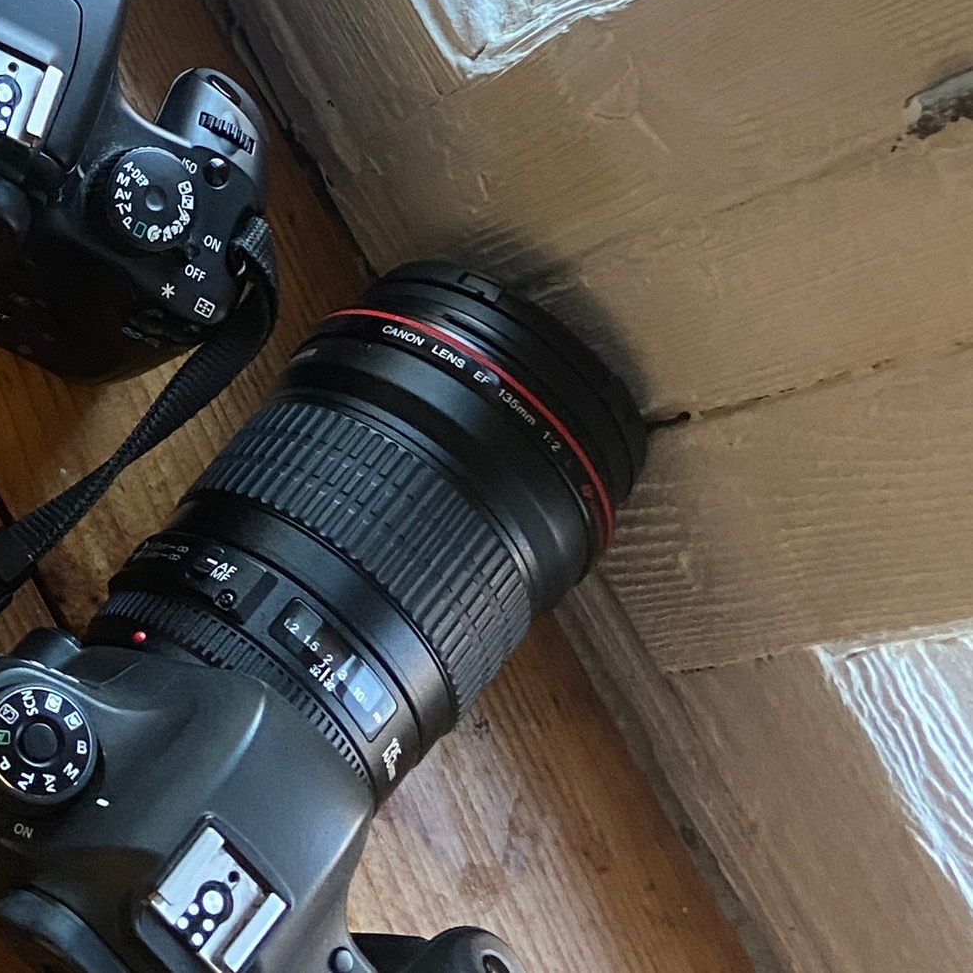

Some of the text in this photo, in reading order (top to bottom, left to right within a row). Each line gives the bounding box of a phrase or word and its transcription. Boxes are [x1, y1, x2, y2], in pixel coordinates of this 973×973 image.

[123, 161, 149, 187] A-DEP
[181, 158, 198, 174] ISO
[116, 172, 131, 187] M
[114, 188, 132, 200] Av
[115, 202, 132, 215] Tv
[122, 216, 133, 230] P
[203, 235, 221, 252] ON
[184, 264, 206, 282] OFF
[382, 325, 426, 347] CANON
[431, 344, 466, 369] LENS
[473, 370, 492, 384] EF
[497, 388, 536, 426] 135mm
[542, 430, 561, 452] 1:2
[210, 568, 231, 582] MF
[218, 562, 238, 575] AF
[302, 634, 320, 652] 1.5
[323, 654, 334, 665] 2
[337, 669, 348, 682] 3
[309, 664, 321, 677] 32
[21, 690, 39, 716] SCN
[76, 740, 87, 754] B
[0, 756, 11, 770] P
[382, 737, 402, 781] 135
[63, 762, 80, 780] M
[17, 772, 35, 790] Tv
[42, 773, 56, 792] Av
[14, 823, 34, 838] ON
